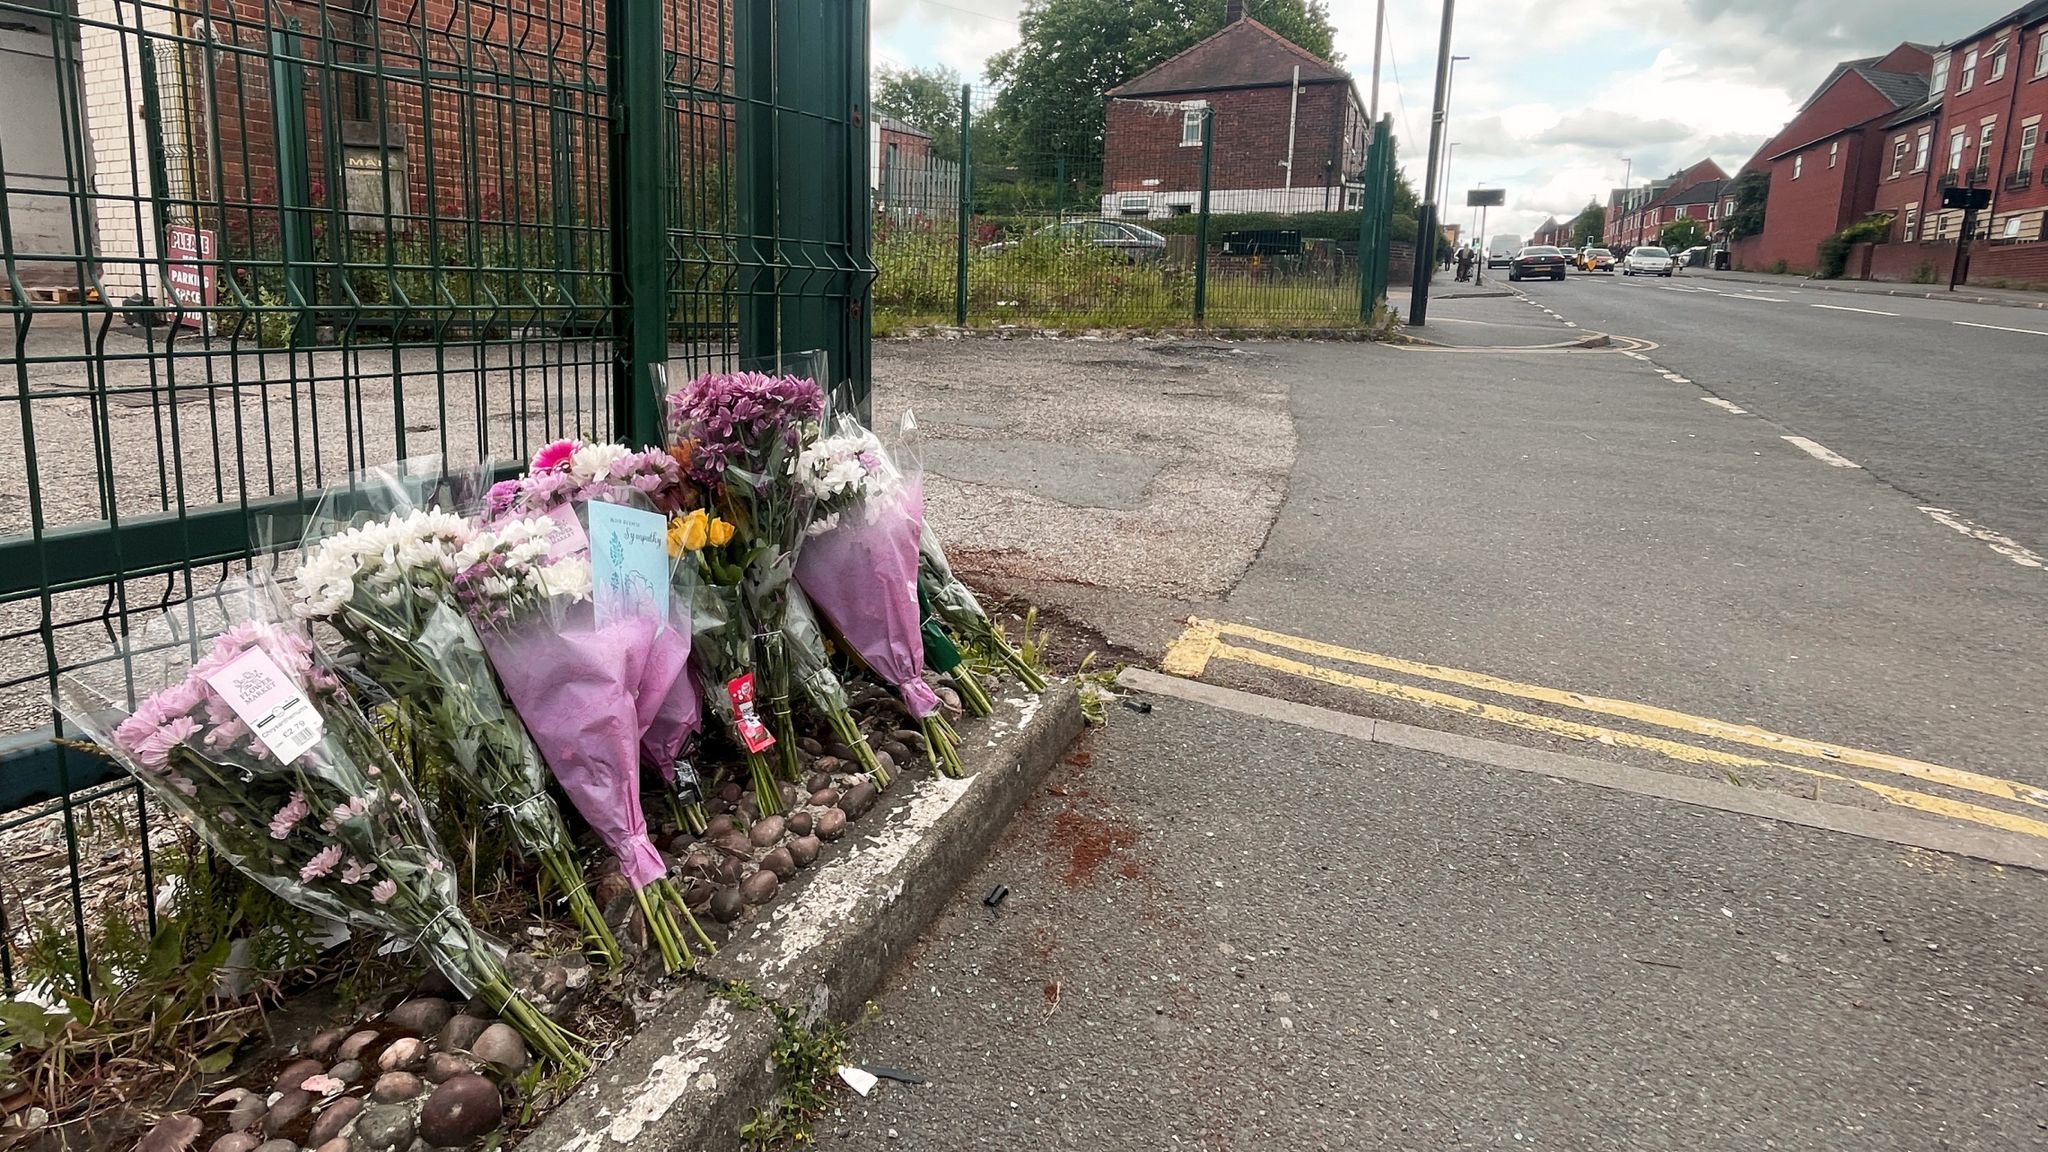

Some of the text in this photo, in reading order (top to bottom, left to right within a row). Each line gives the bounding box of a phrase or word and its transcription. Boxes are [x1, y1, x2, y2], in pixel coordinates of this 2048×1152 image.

[349, 157, 392, 167] MAI
[171, 231, 209, 254] PLEAE
[624, 527, 662, 549] Sympathy
[240, 677, 272, 700] FLOWER
[244, 681, 276, 704] MARKET
